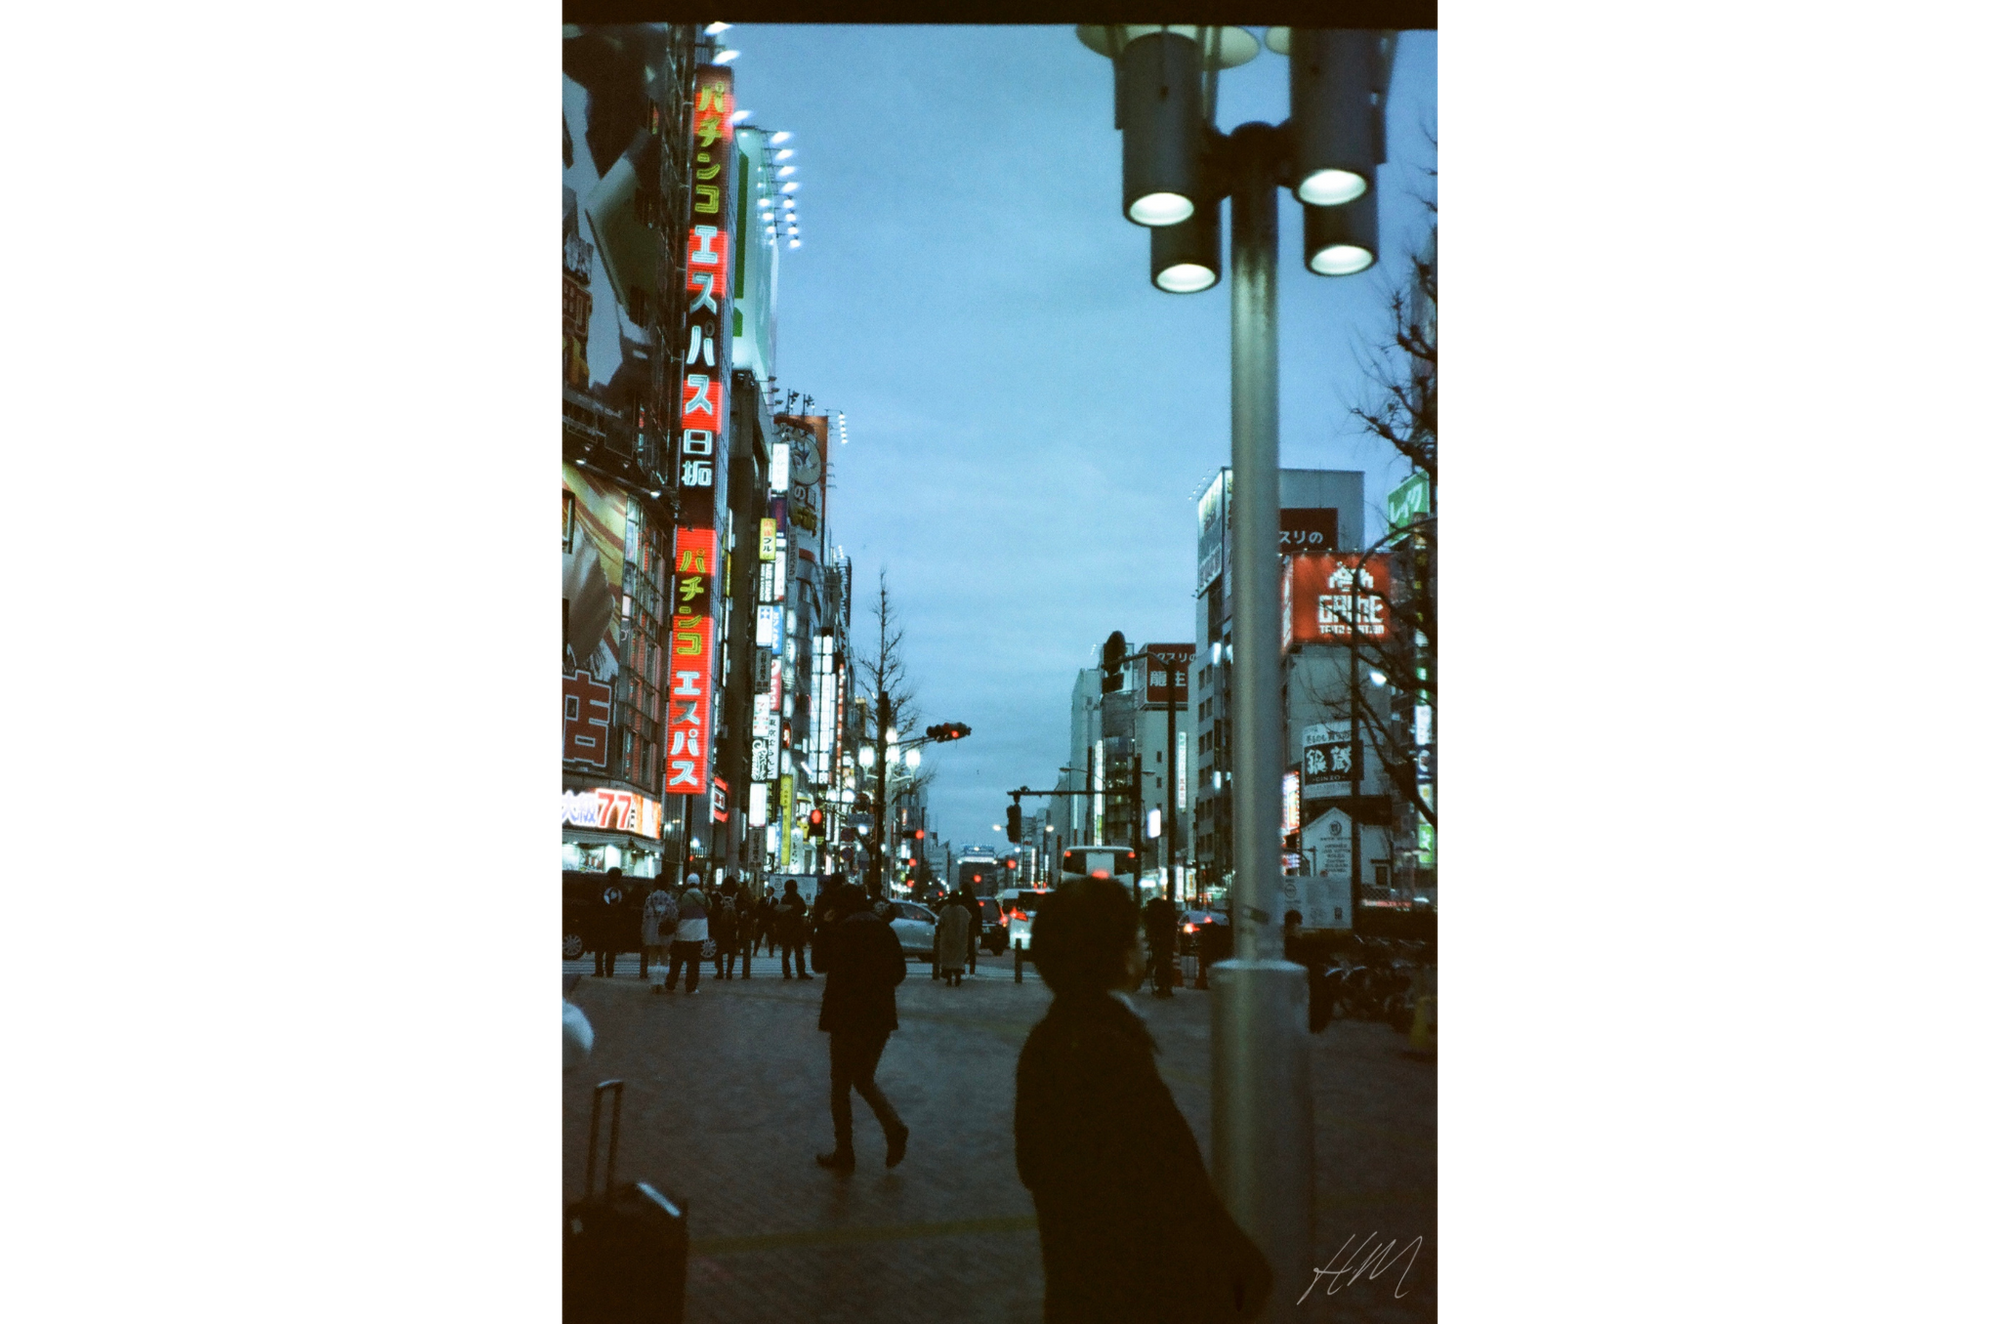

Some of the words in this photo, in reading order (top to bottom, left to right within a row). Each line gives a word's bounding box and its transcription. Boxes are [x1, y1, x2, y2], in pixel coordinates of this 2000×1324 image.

[694, 81, 725, 214] パチンコ
[677, 549, 706, 655] パチンコ
[1319, 595, 1384, 623] GAME
[669, 671, 701, 786] エスパス
